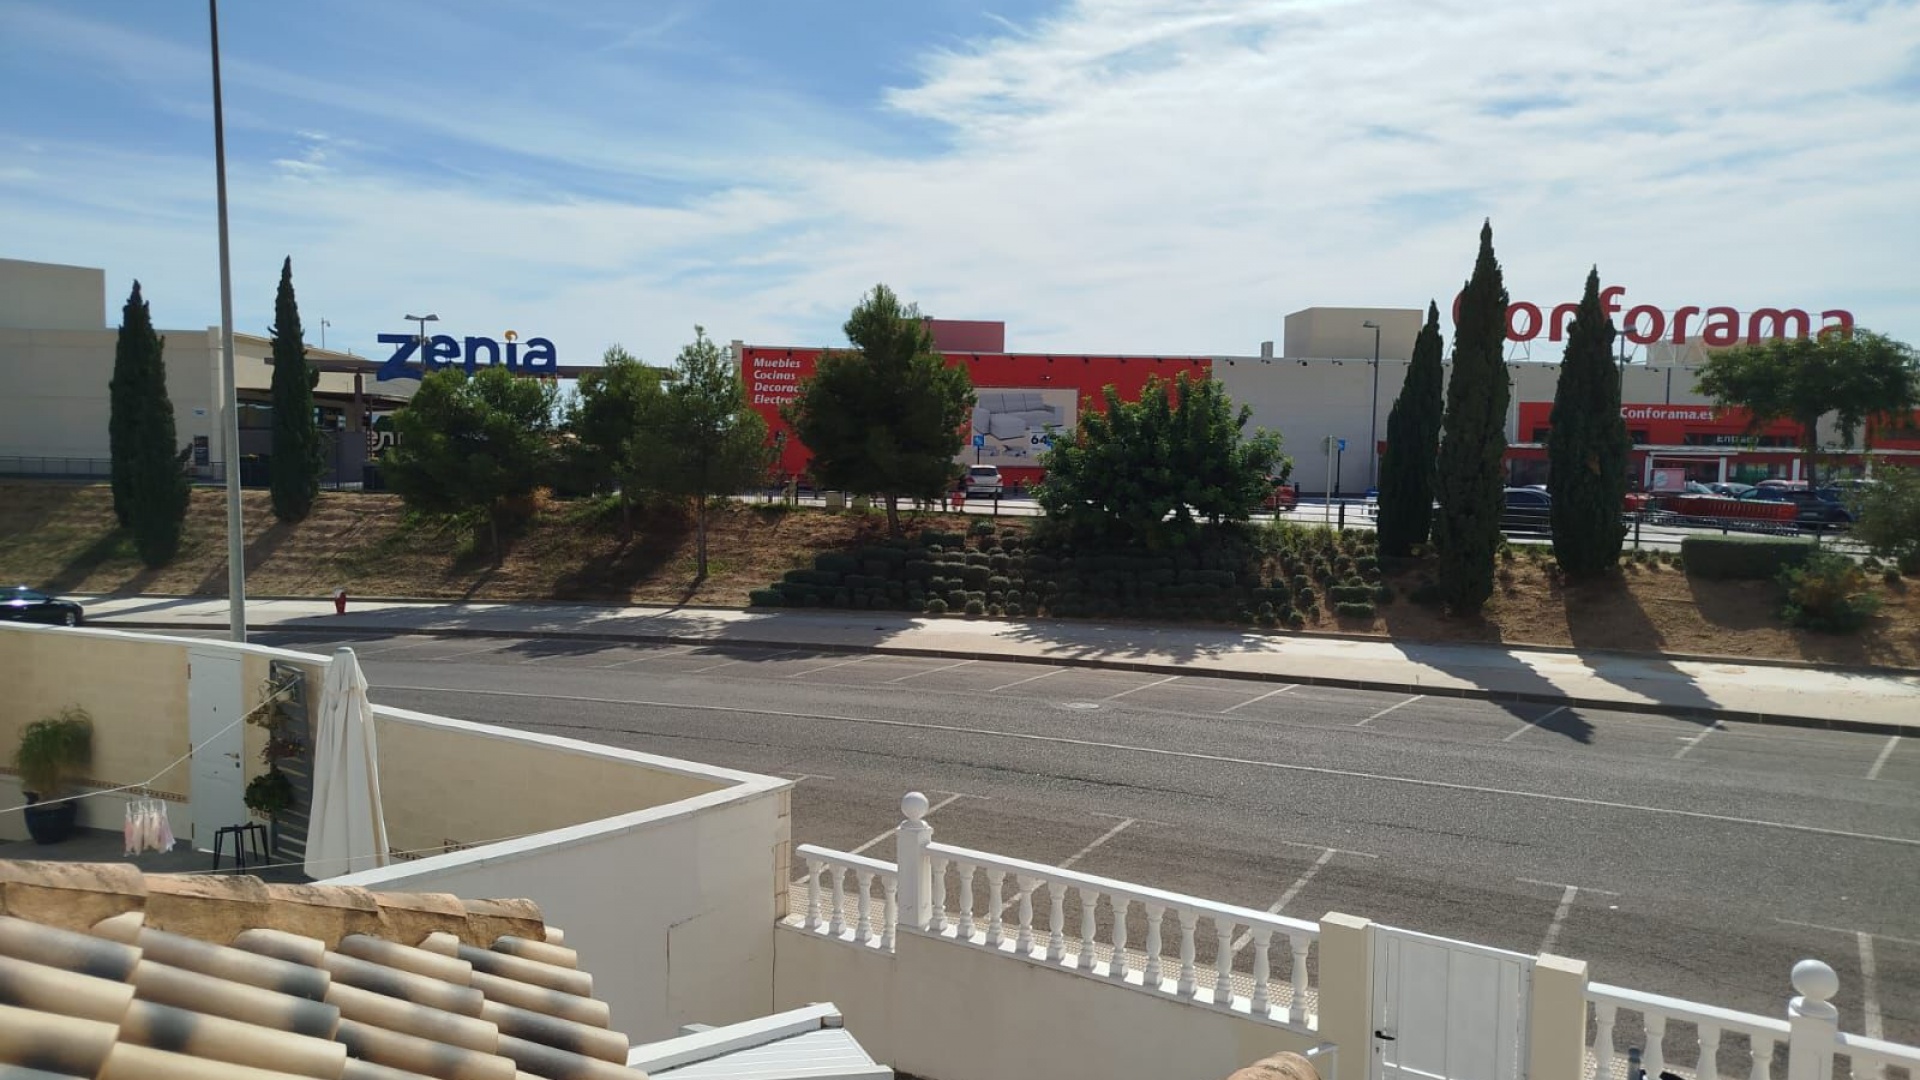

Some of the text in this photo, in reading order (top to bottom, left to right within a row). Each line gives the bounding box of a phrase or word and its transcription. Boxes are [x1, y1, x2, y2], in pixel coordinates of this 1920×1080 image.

[1453, 286, 1854, 346] onforama
[754, 358, 801, 368] Muebles
[754, 370, 796, 380] Cocinas
[754, 382, 806, 392] Decorac
[754, 395, 793, 404] Electro
